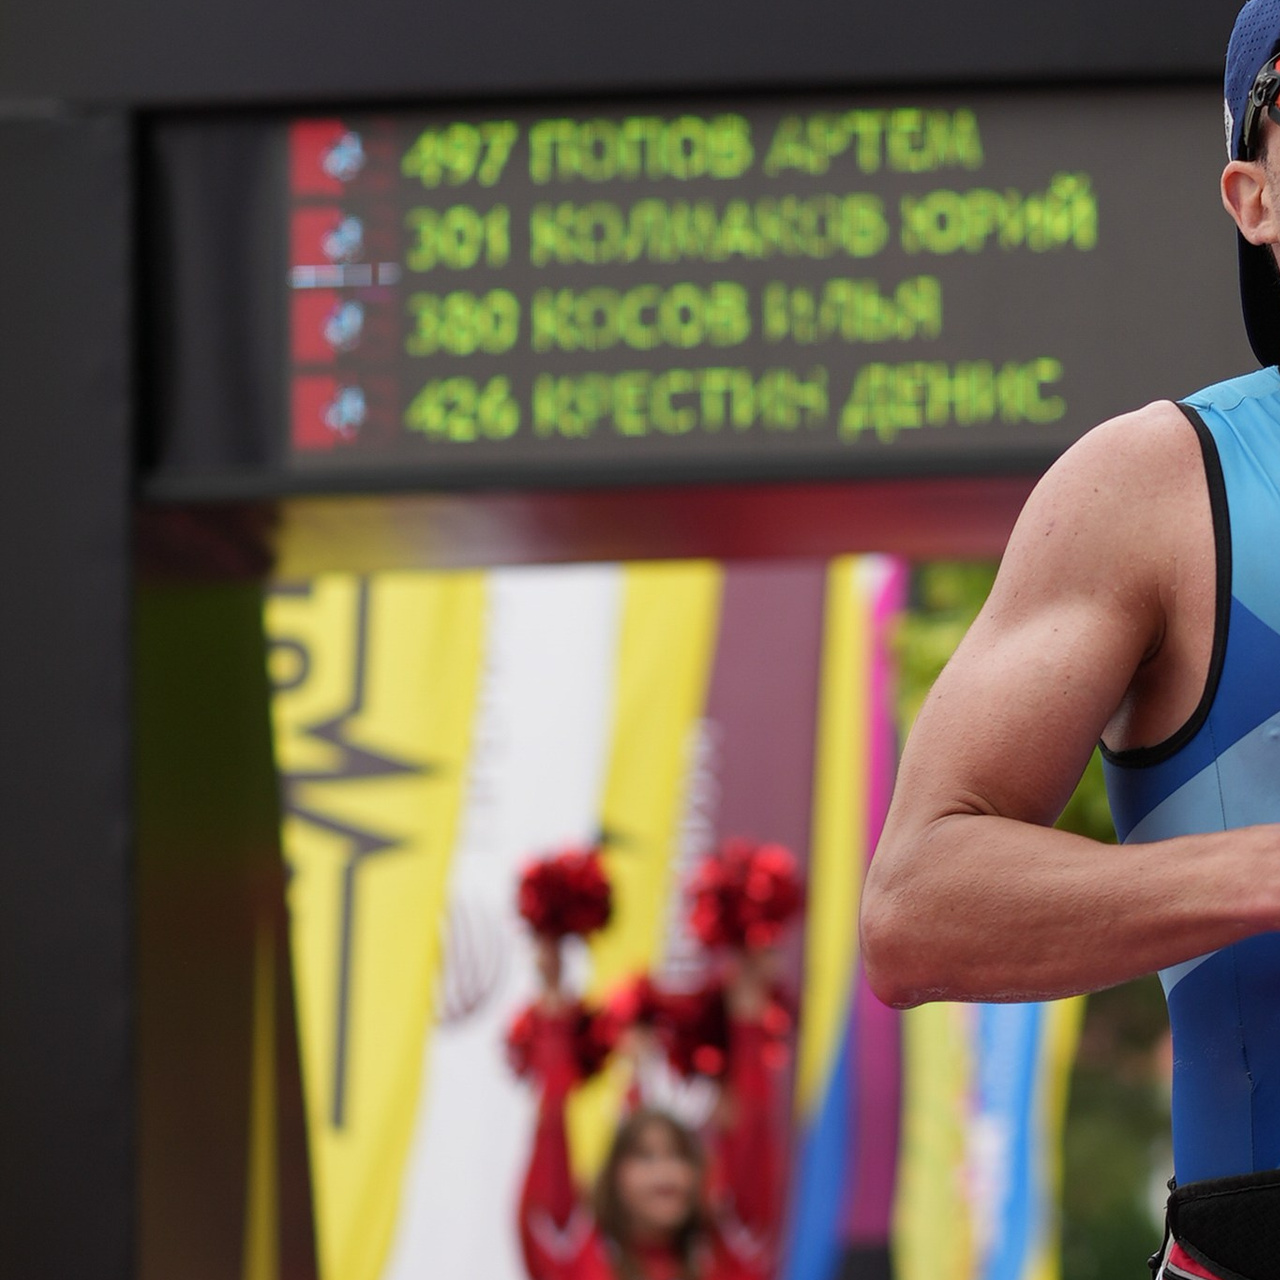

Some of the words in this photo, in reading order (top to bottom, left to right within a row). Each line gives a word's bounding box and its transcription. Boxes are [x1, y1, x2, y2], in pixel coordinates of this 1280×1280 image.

[402, 120, 519, 186] 497
[529, 114, 754, 182] ПОПОВ
[531, 281, 751, 350] КОСОВ
[405, 376, 520, 443] 426
